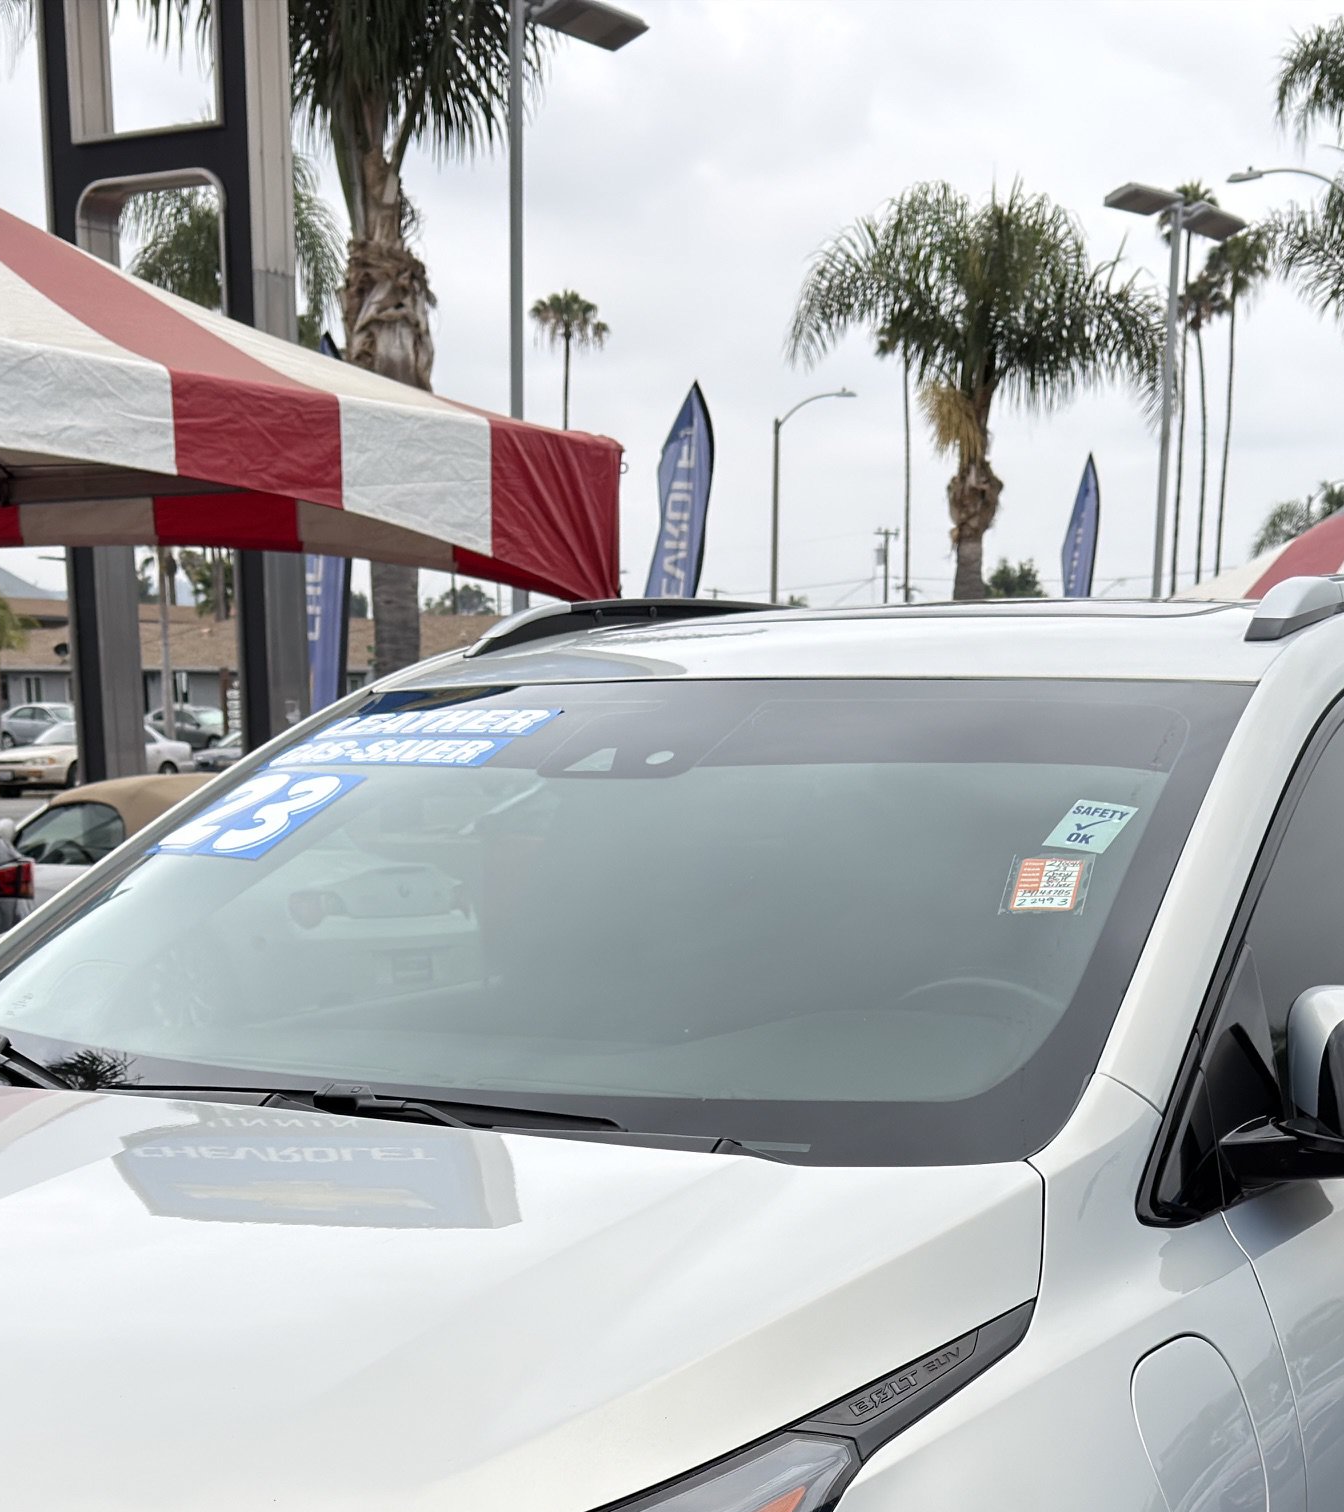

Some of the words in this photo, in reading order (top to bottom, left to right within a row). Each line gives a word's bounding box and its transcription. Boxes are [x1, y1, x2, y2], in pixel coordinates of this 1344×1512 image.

[315, 709, 551, 738] LEATHER
[157, 772, 344, 852] 23
[1072, 805, 1130, 820] SAFETY
[1066, 832, 1095, 845] OK
